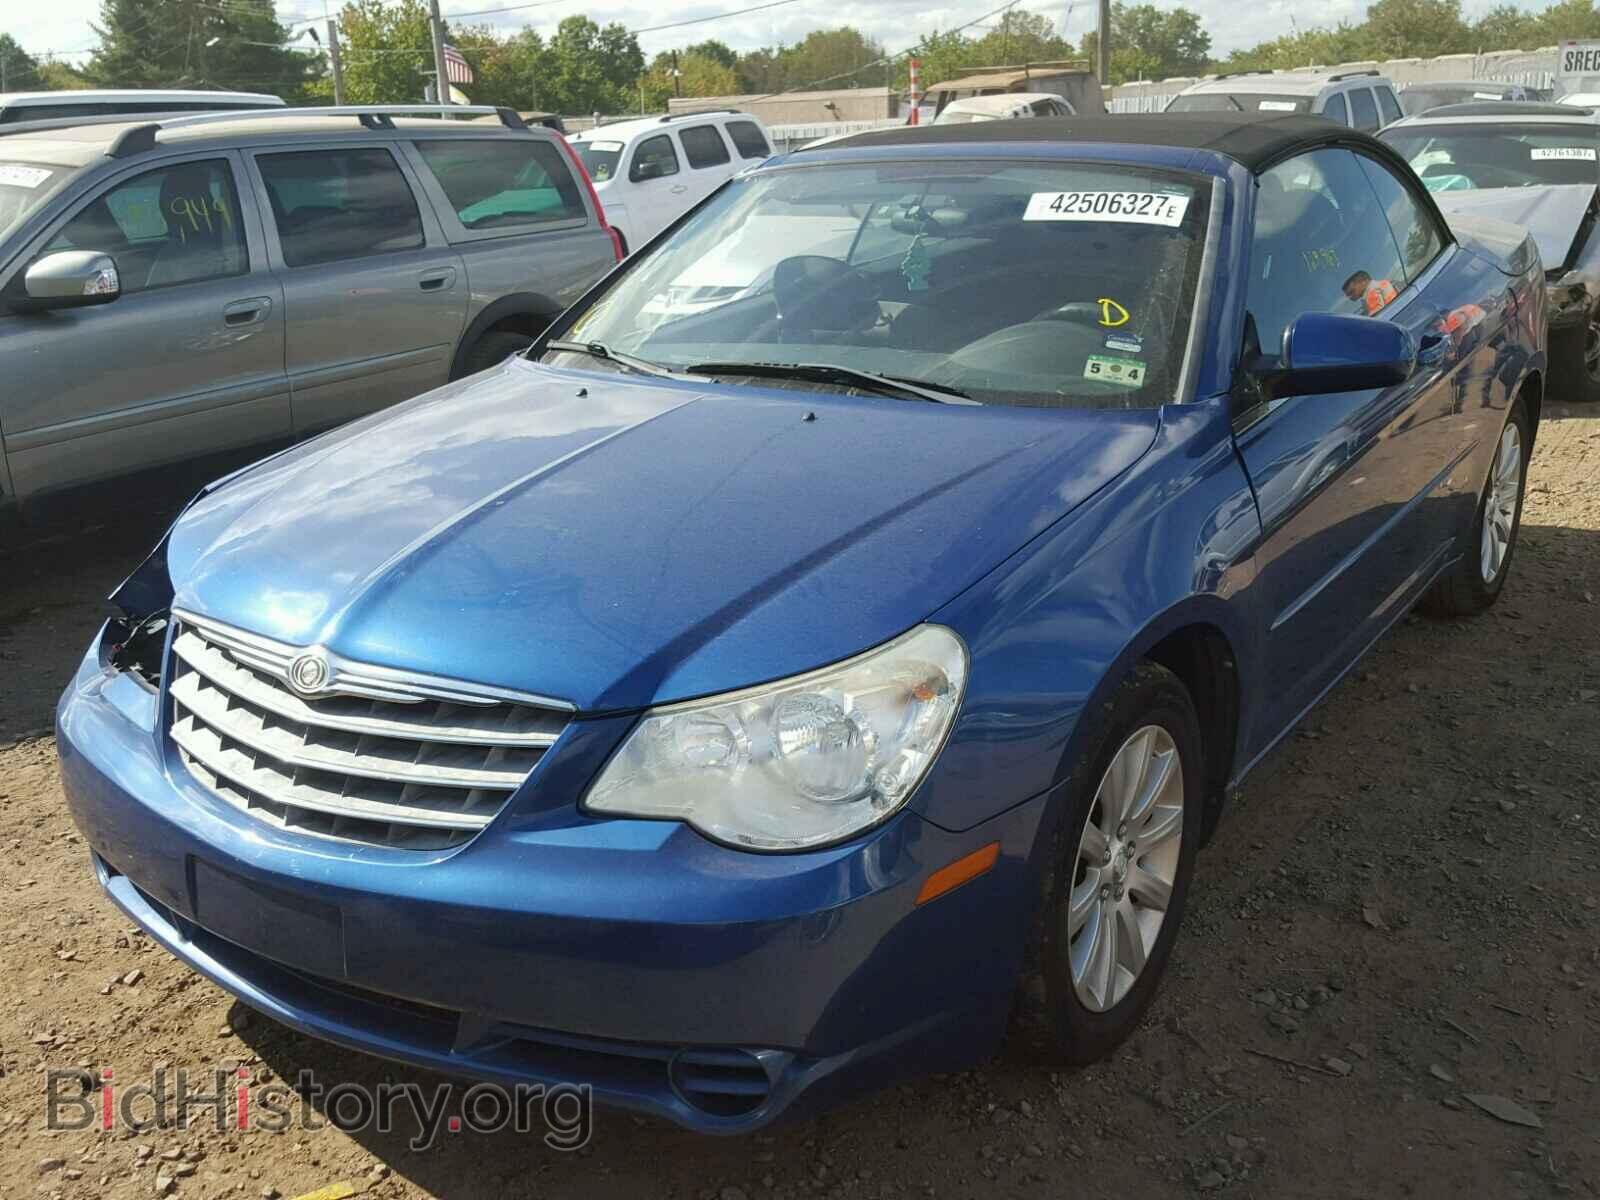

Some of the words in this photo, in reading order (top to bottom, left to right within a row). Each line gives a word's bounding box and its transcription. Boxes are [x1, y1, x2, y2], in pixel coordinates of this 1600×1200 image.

[1097, 297, 1130, 327] D
[1090, 362, 1101, 374] 5
[1128, 368, 1138, 380] 4
